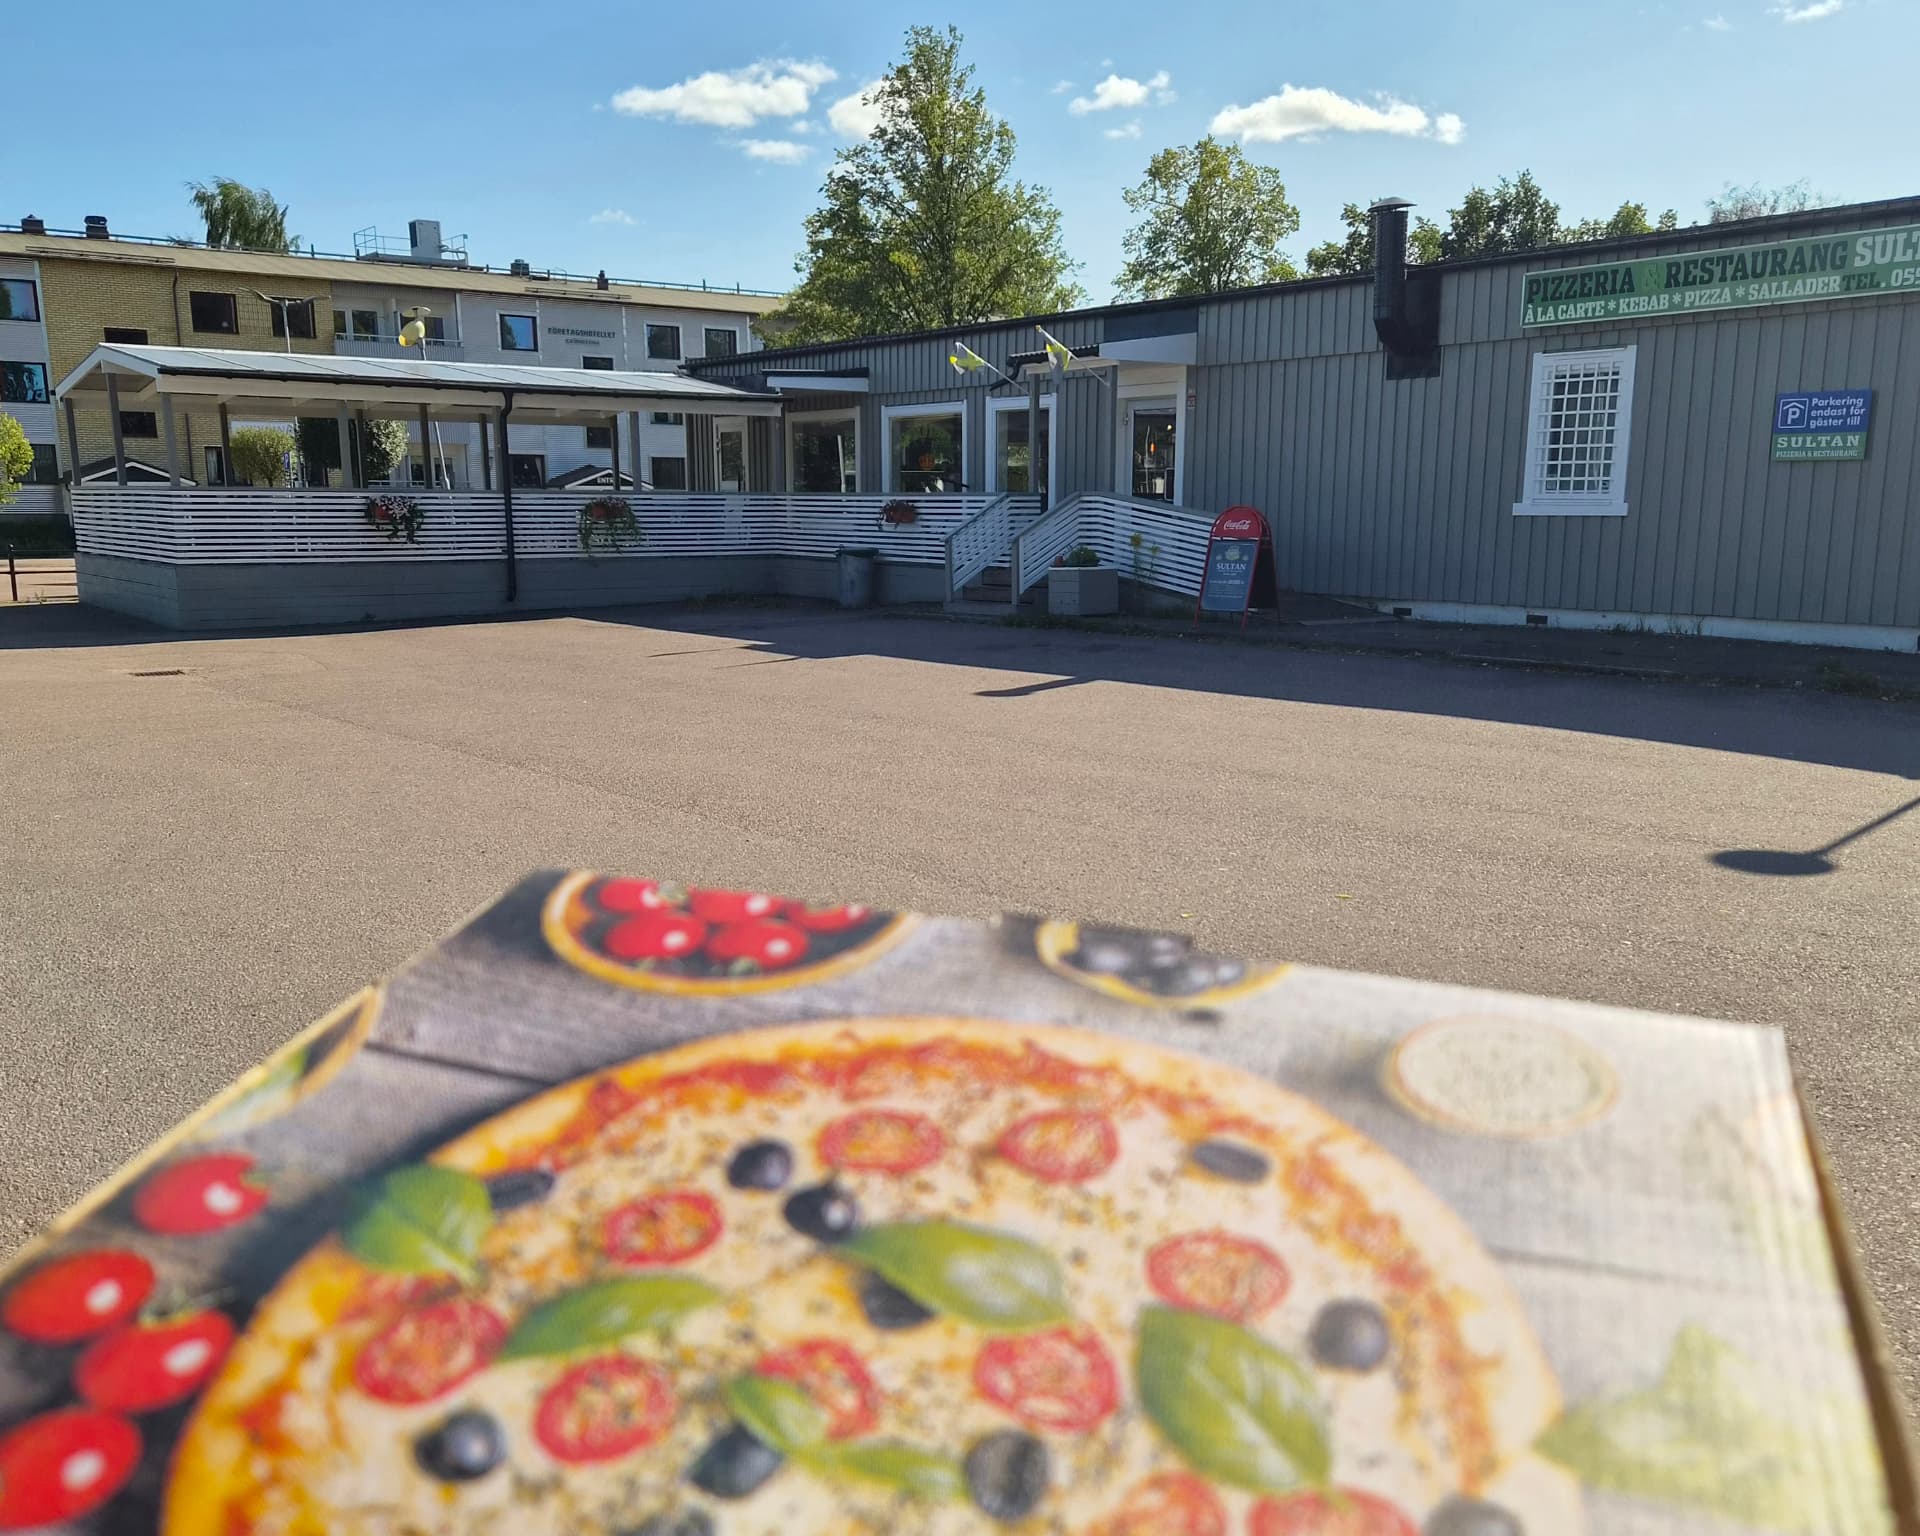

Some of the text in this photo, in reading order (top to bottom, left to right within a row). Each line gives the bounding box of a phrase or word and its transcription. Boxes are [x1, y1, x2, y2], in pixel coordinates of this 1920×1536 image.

[1527, 267, 1635, 304] PIZZERIA
[1664, 241, 1848, 289] RESTAURANG
[1536, 305, 1555, 322] LA
[1557, 300, 1605, 319] CARTE
[1619, 293, 1670, 313] KEBAB
[1684, 287, 1732, 308] PIZZA
[1748, 275, 1841, 301] SALLADER
[1812, 396, 1864, 408] Parkering
[1811, 406, 1866, 417] endast för
[1809, 415, 1861, 428] gäster till
[1777, 435, 1860, 448] SULTAN
[1216, 562, 1247, 570] SULTAN
